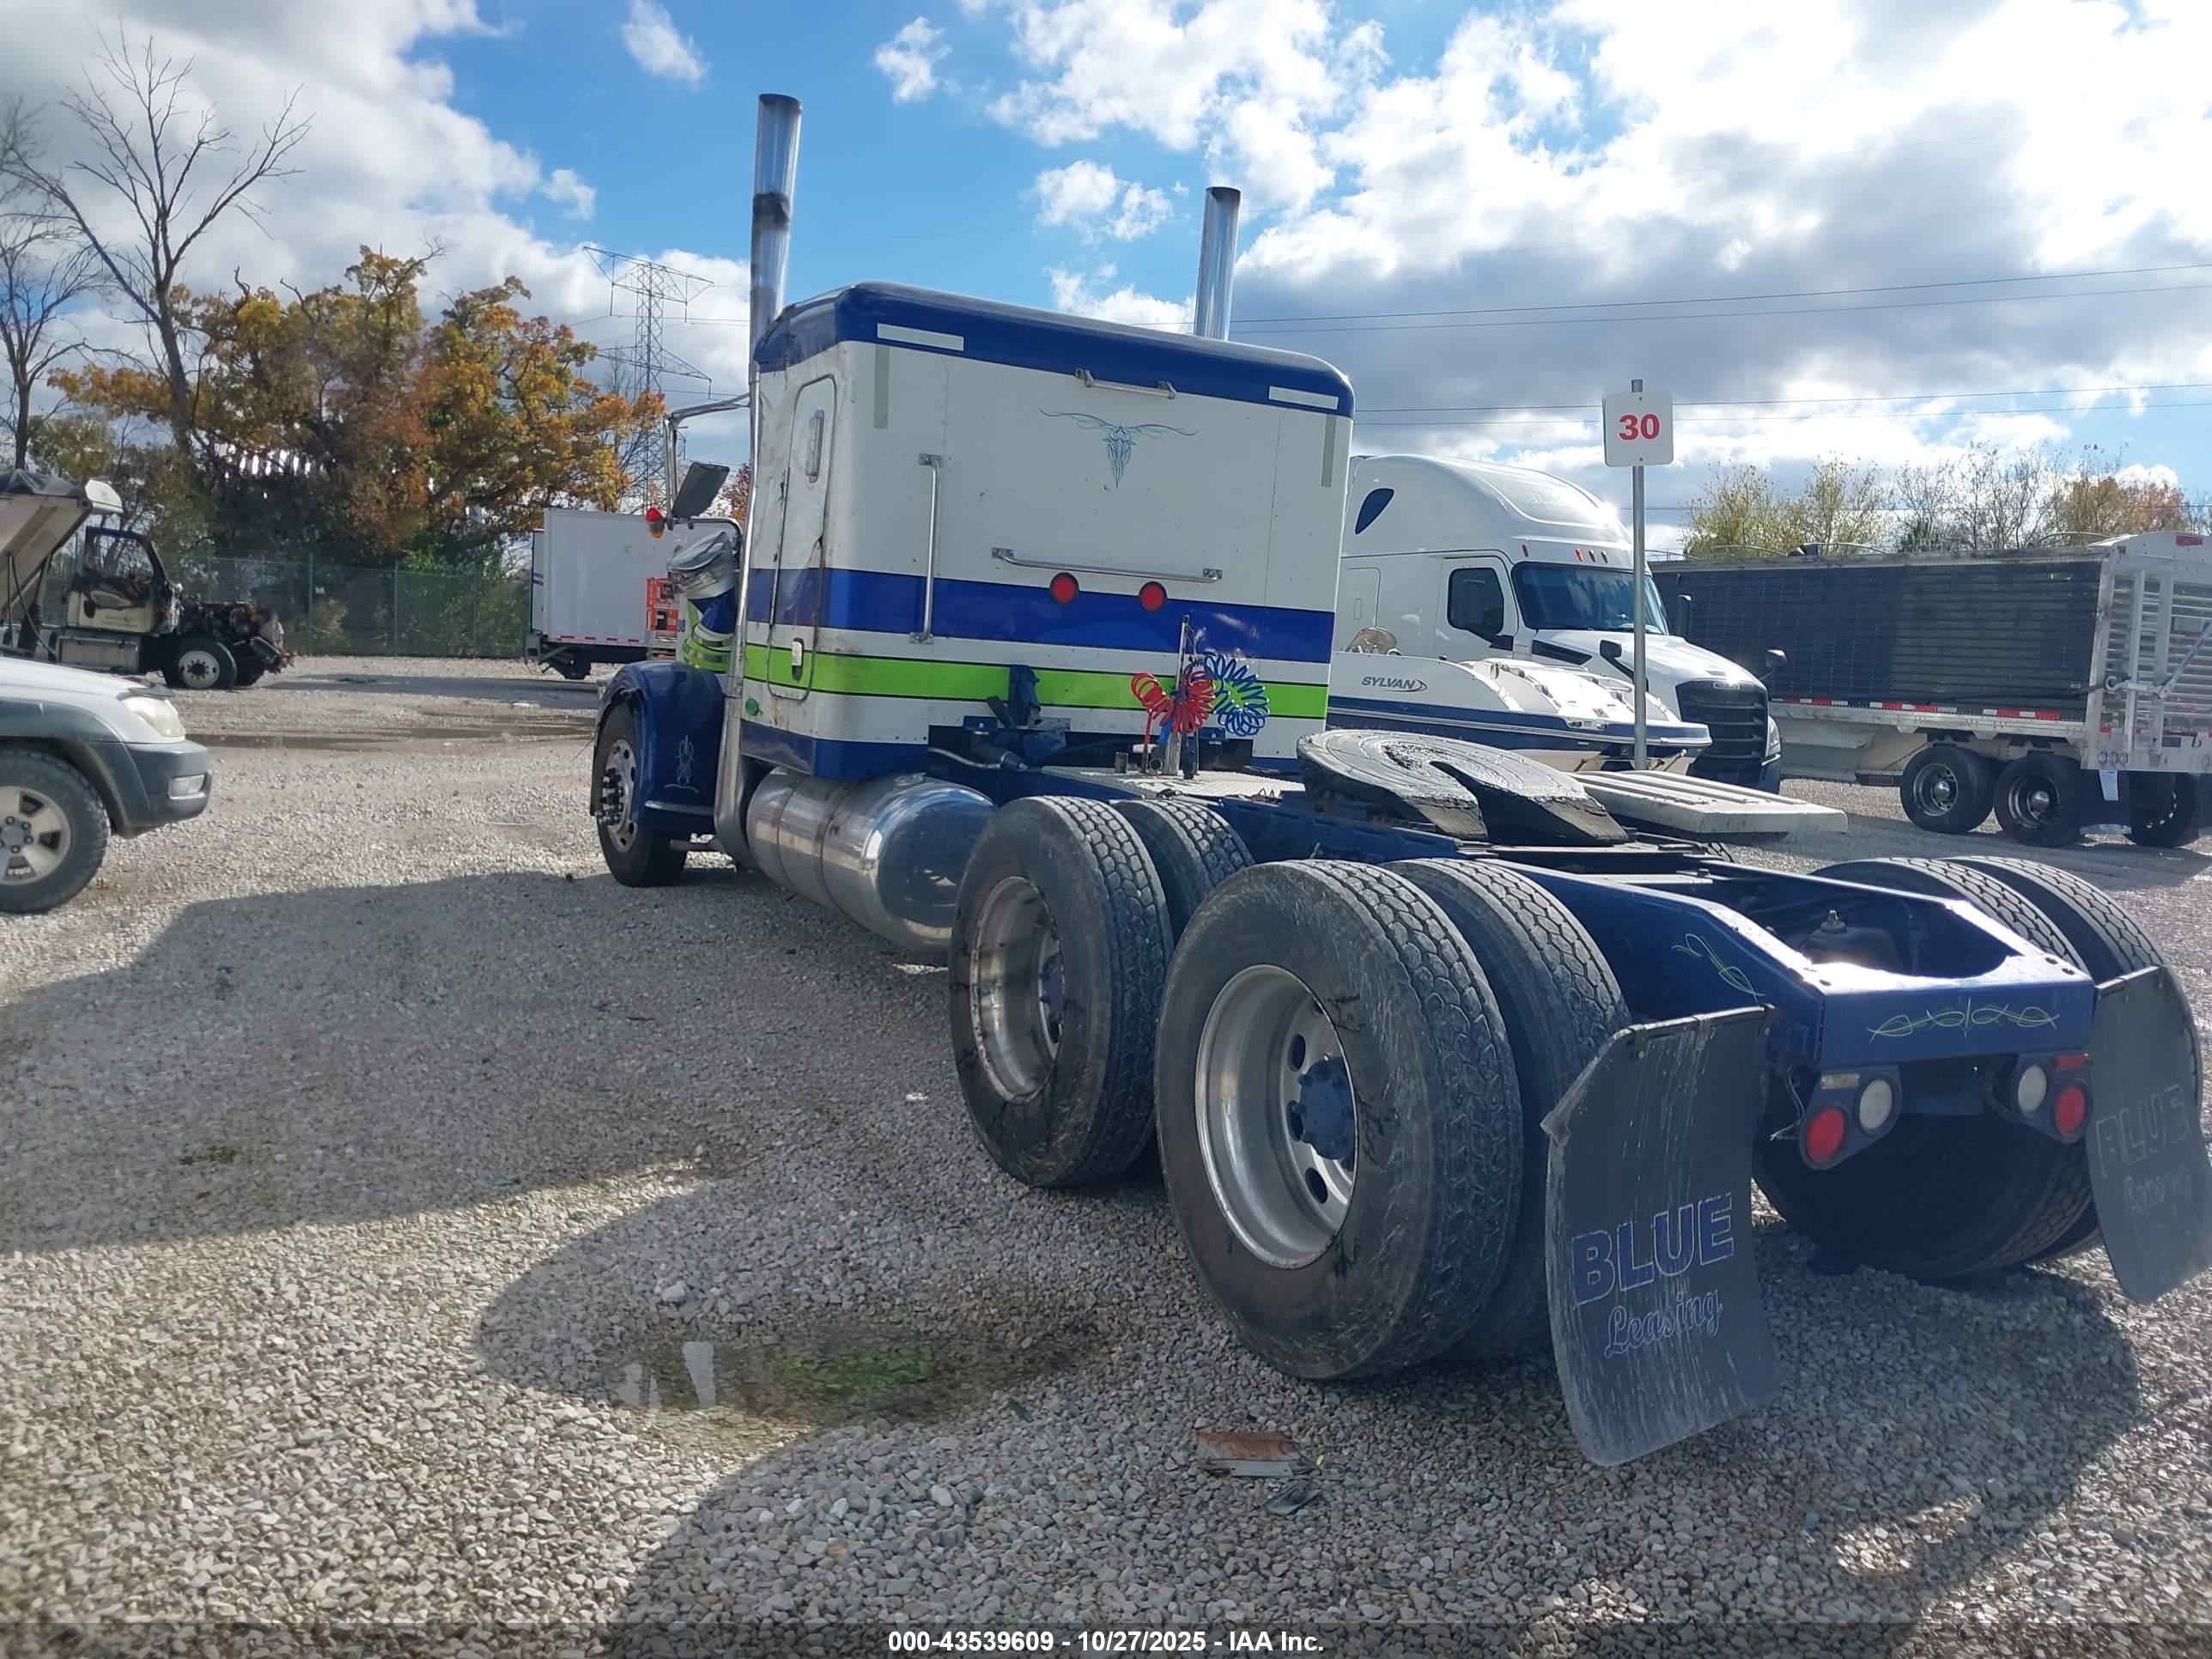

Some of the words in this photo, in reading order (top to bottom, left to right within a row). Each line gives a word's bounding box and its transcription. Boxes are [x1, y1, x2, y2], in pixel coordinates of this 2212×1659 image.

[1619, 413, 1660, 441] 30
[1361, 676, 1416, 690] SYLVAN
[2096, 1084, 2191, 1179] BLUE
[1571, 1192, 1735, 1306] BLUE
[1604, 1290, 1723, 1358] Leasing
